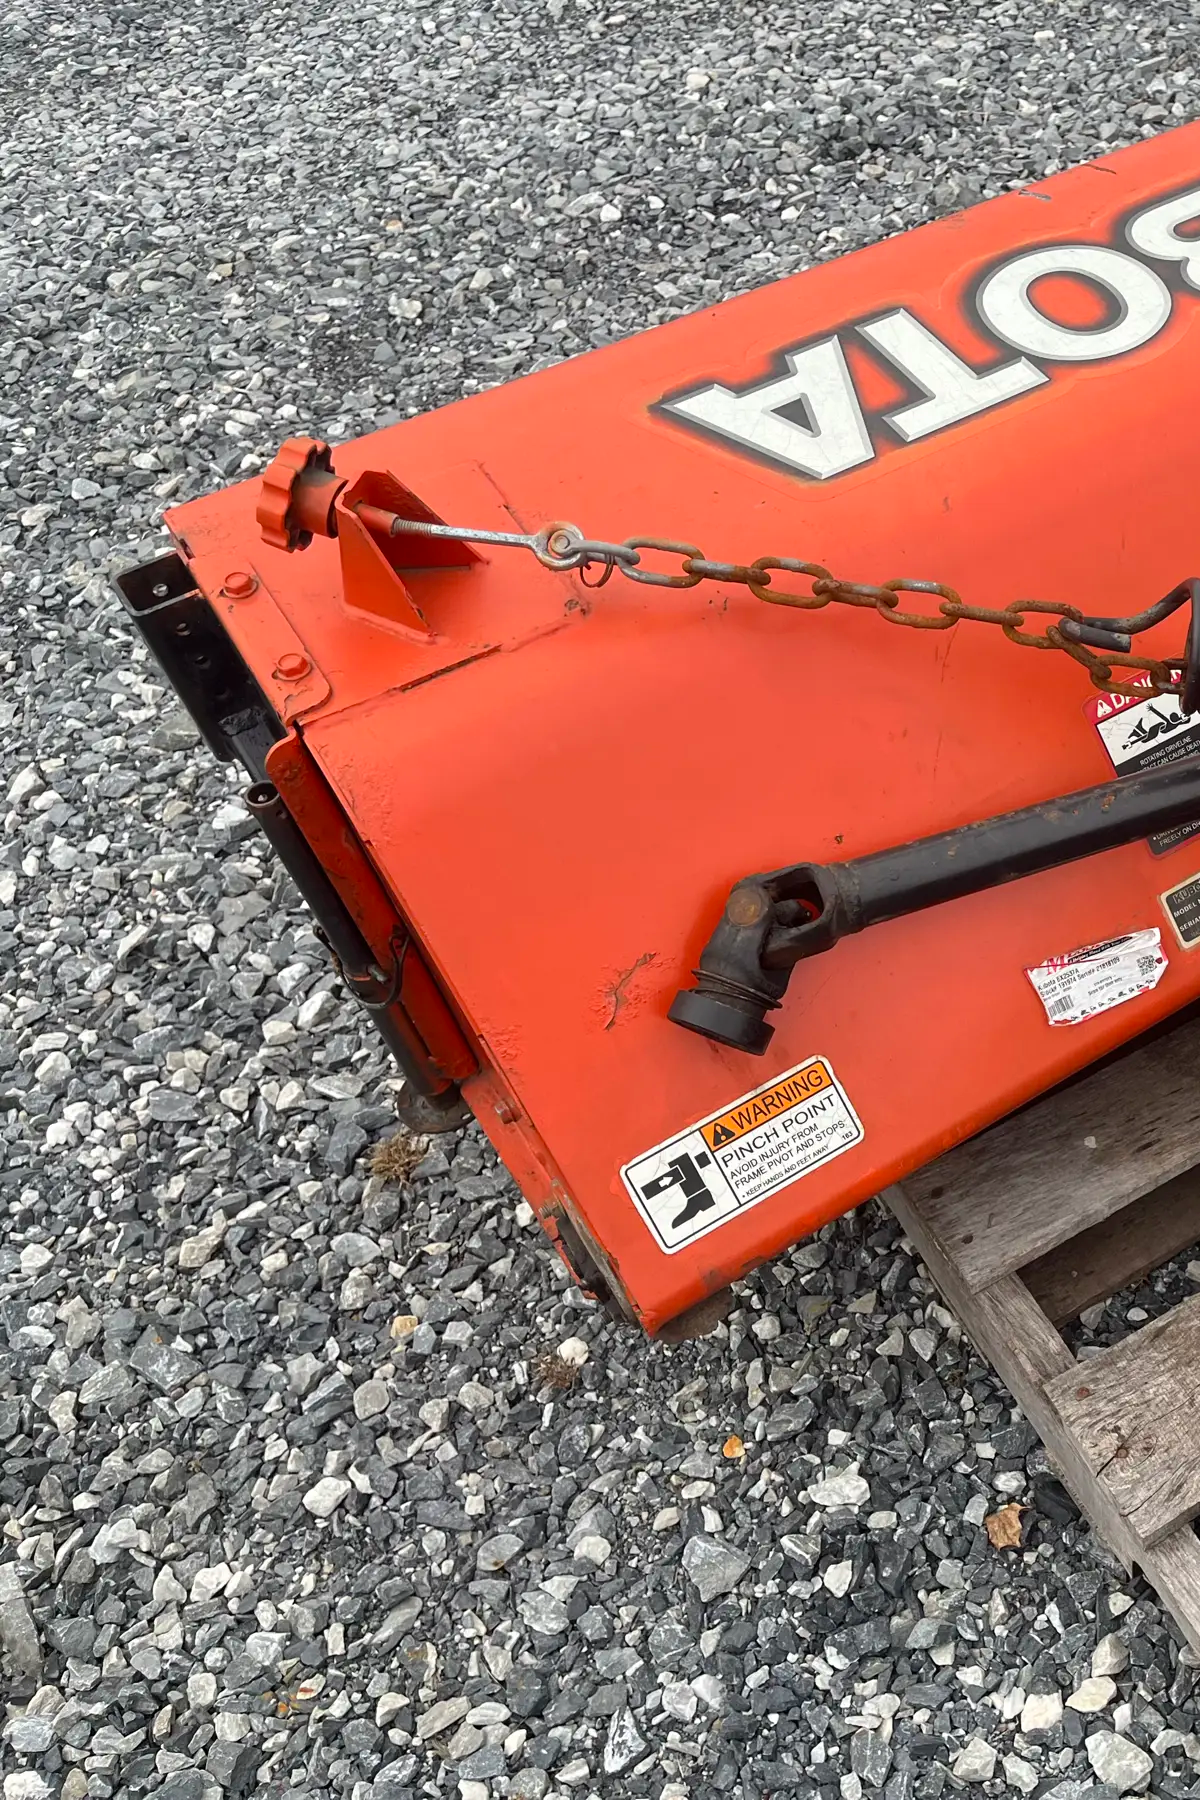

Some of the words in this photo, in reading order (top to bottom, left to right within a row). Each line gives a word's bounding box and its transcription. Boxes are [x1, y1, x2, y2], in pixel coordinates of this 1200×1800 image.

[1140, 749, 1165, 765] ROTATING
[1165, 736, 1192, 753] DRIVELINE
[1156, 756, 1169, 766] CAN
[1169, 748, 1184, 759] CAUSE
[1160, 831, 1181, 846] FREELY
[1182, 825, 1192, 835] ON
[1174, 902, 1196, 917] MODEL
[731, 1067, 824, 1131] WARNING
[721, 1127, 780, 1168] PINCH
[781, 1093, 838, 1133] POINT
[729, 1158, 758, 1179] AVOID
[759, 1139, 792, 1162] INJURY
[792, 1123, 818, 1143] FROM
[734, 1166, 766, 1188] FRAME
[767, 1149, 795, 1169] PIVOT
[795, 1138, 814, 1153] AND
[746, 1184, 762, 1196] KEEP
[762, 1171, 783, 1187] HANDS
[784, 1163, 797, 1174] AND
[797, 1154, 812, 1166] FEET
[812, 1144, 830, 1157] AWAY
